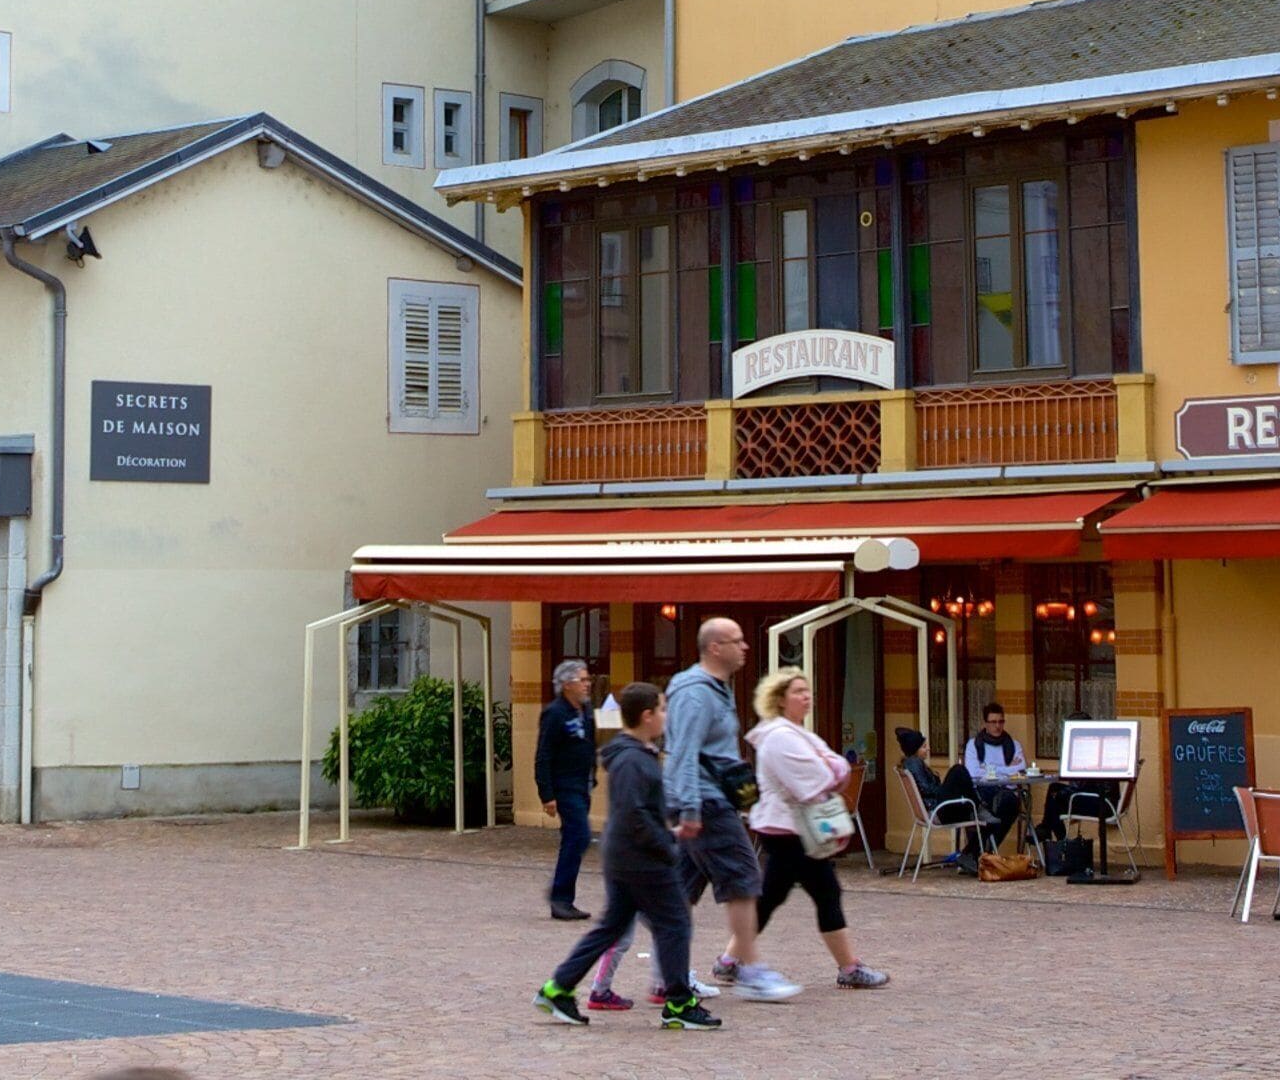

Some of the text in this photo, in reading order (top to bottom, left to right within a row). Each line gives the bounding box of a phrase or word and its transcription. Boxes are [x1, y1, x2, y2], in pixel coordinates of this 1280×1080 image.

[744, 336, 883, 385] RESTAURANT
[115, 393, 188, 410] SECRETS
[102, 419, 200, 436] DE MAISON
[1174, 744, 1246, 764] GAUFRES
